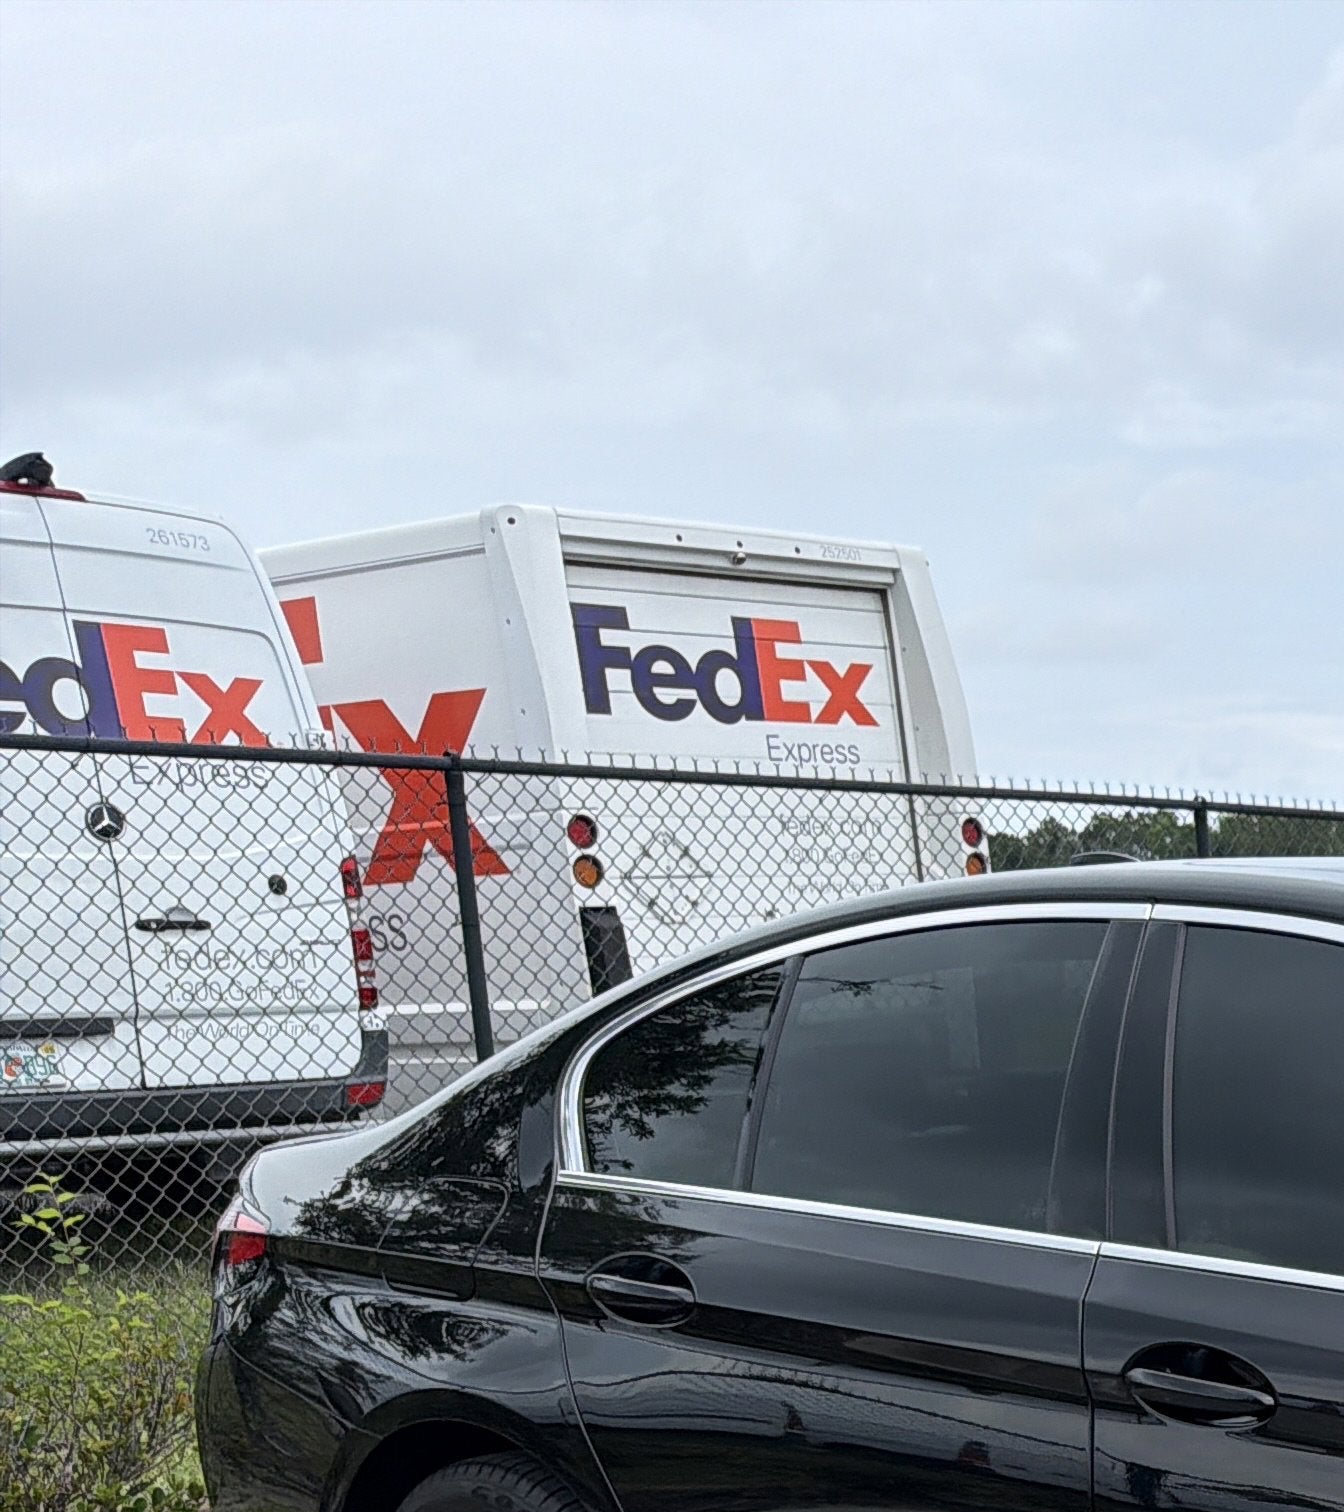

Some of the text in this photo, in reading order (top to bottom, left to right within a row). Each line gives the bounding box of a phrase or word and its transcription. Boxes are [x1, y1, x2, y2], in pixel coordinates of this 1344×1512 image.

[570, 602, 880, 726] FedEx
[766, 734, 861, 768] Express
[161, 942, 319, 971] fedex.com
